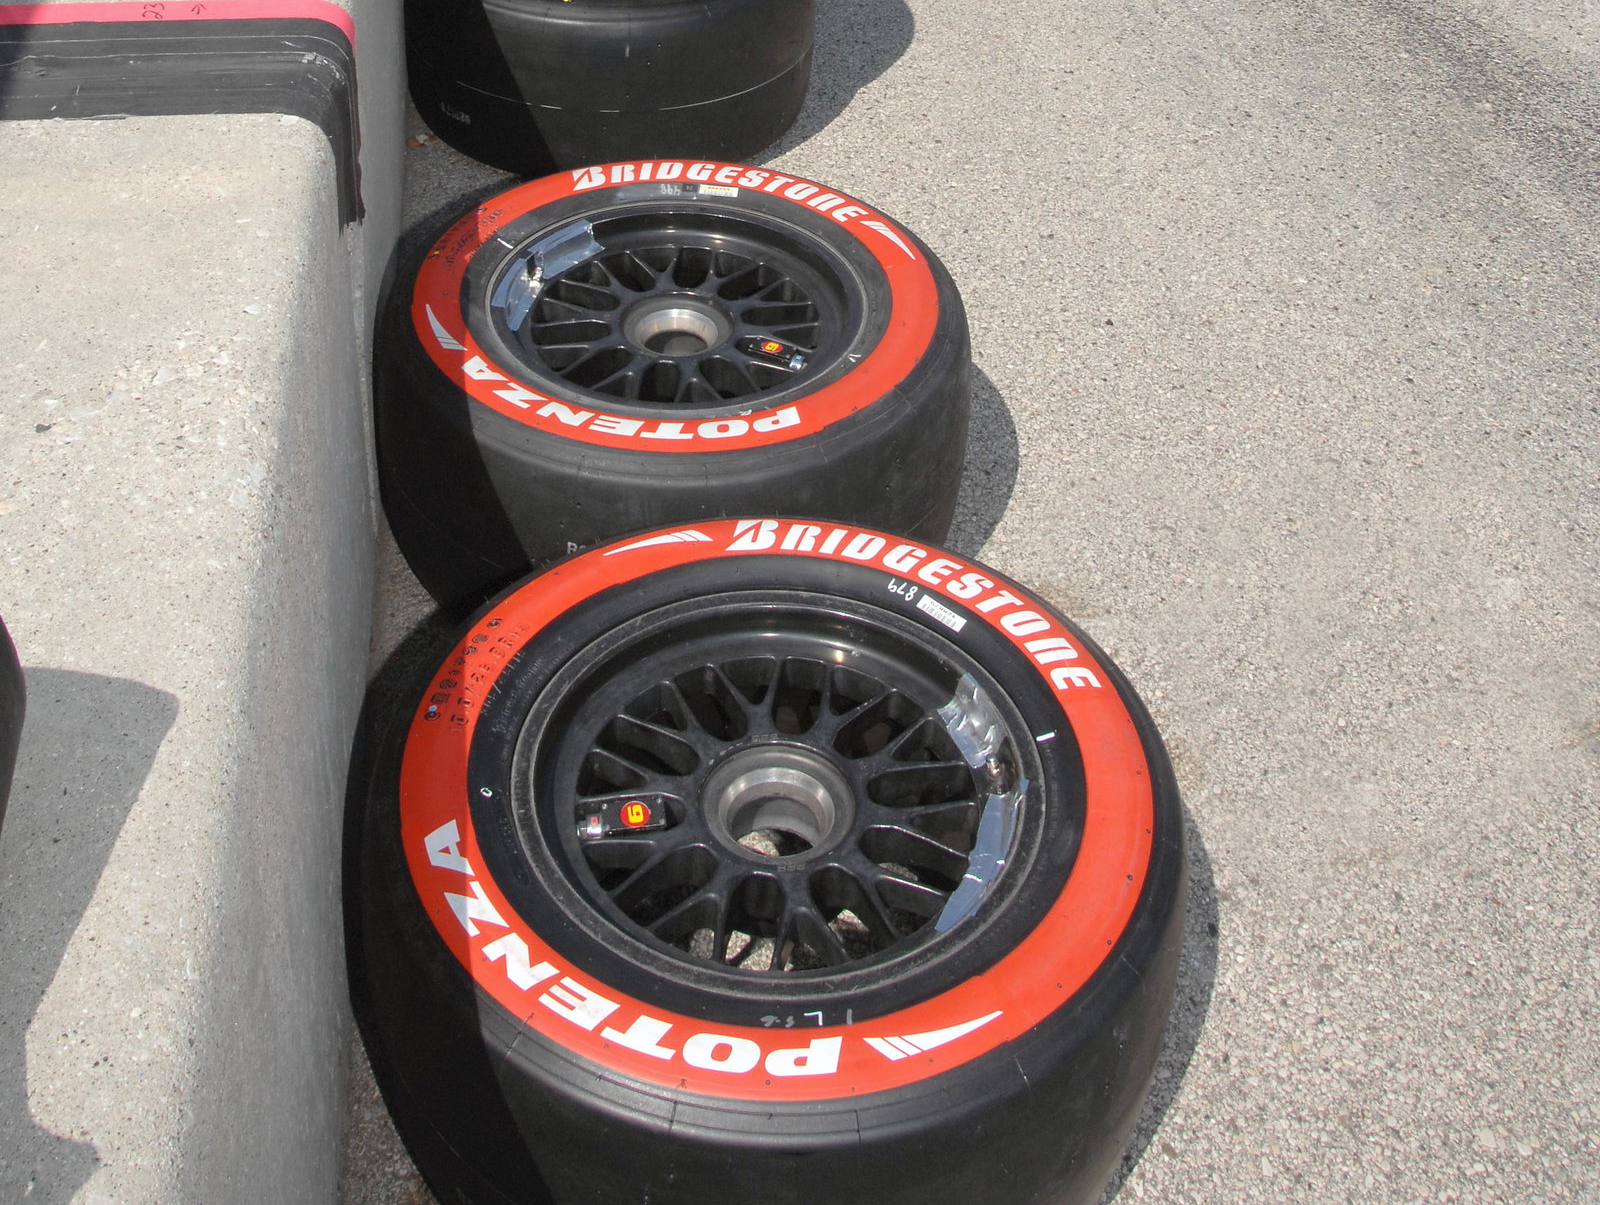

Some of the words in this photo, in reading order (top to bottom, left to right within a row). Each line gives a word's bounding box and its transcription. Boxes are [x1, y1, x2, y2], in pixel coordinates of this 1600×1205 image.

[572, 161, 868, 222] BRIDGESTONE
[460, 354, 802, 439] POTENZA
[726, 519, 1102, 691] BRIDGESTONE
[888, 577, 918, 601] 879
[430, 820, 843, 1079] POTENZA
